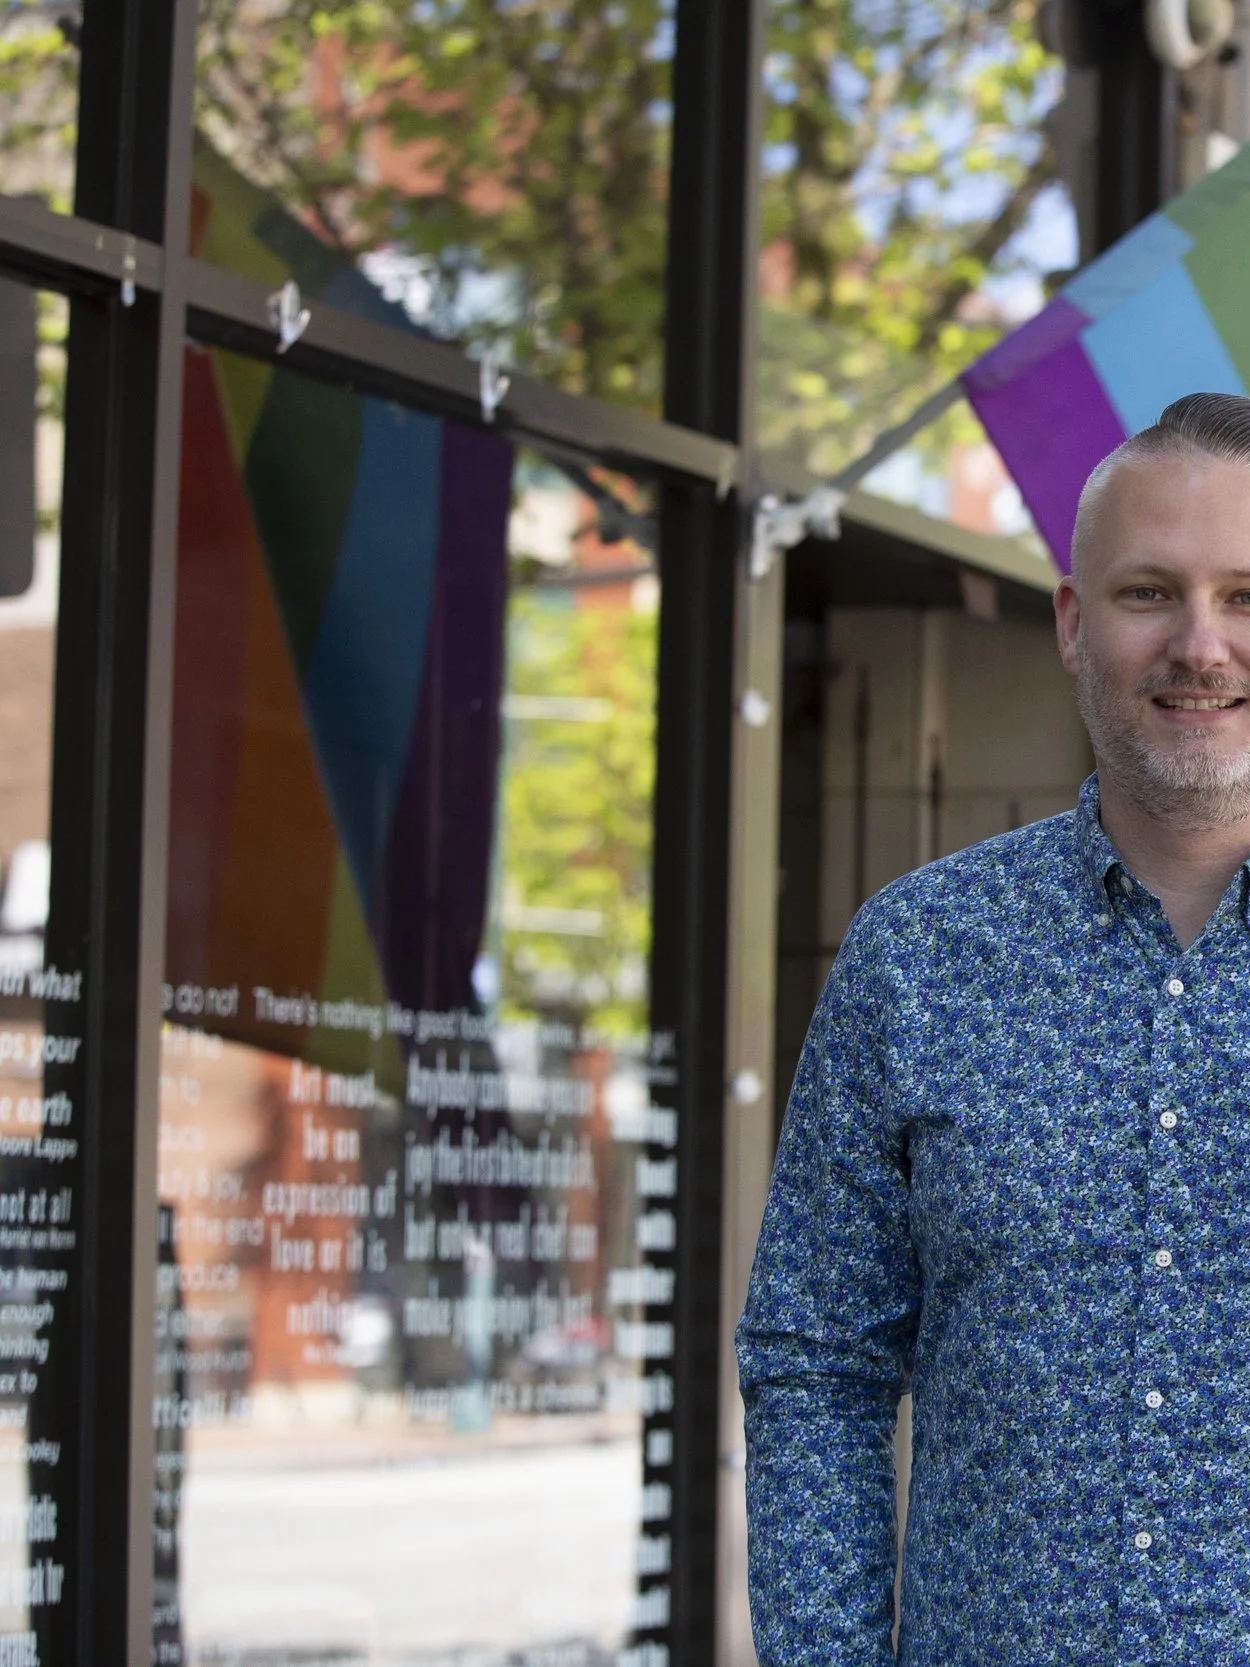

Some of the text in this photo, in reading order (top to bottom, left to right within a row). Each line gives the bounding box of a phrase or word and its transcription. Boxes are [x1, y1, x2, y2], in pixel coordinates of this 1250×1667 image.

[28, 965, 82, 1002] what
[254, 985, 318, 1027] There's
[30, 1034, 82, 1064] your
[289, 1058, 376, 1108] Art must
[16, 1091, 73, 1126] earth
[302, 1112, 360, 1161] be an
[0, 1187, 72, 1224] not at all
[262, 1168, 398, 1226] expression of
[271, 1221, 388, 1273] love or it is
[16, 1266, 68, 1291] human
[1, 1300, 54, 1330] enough
[20, 1368, 38, 1395] to
